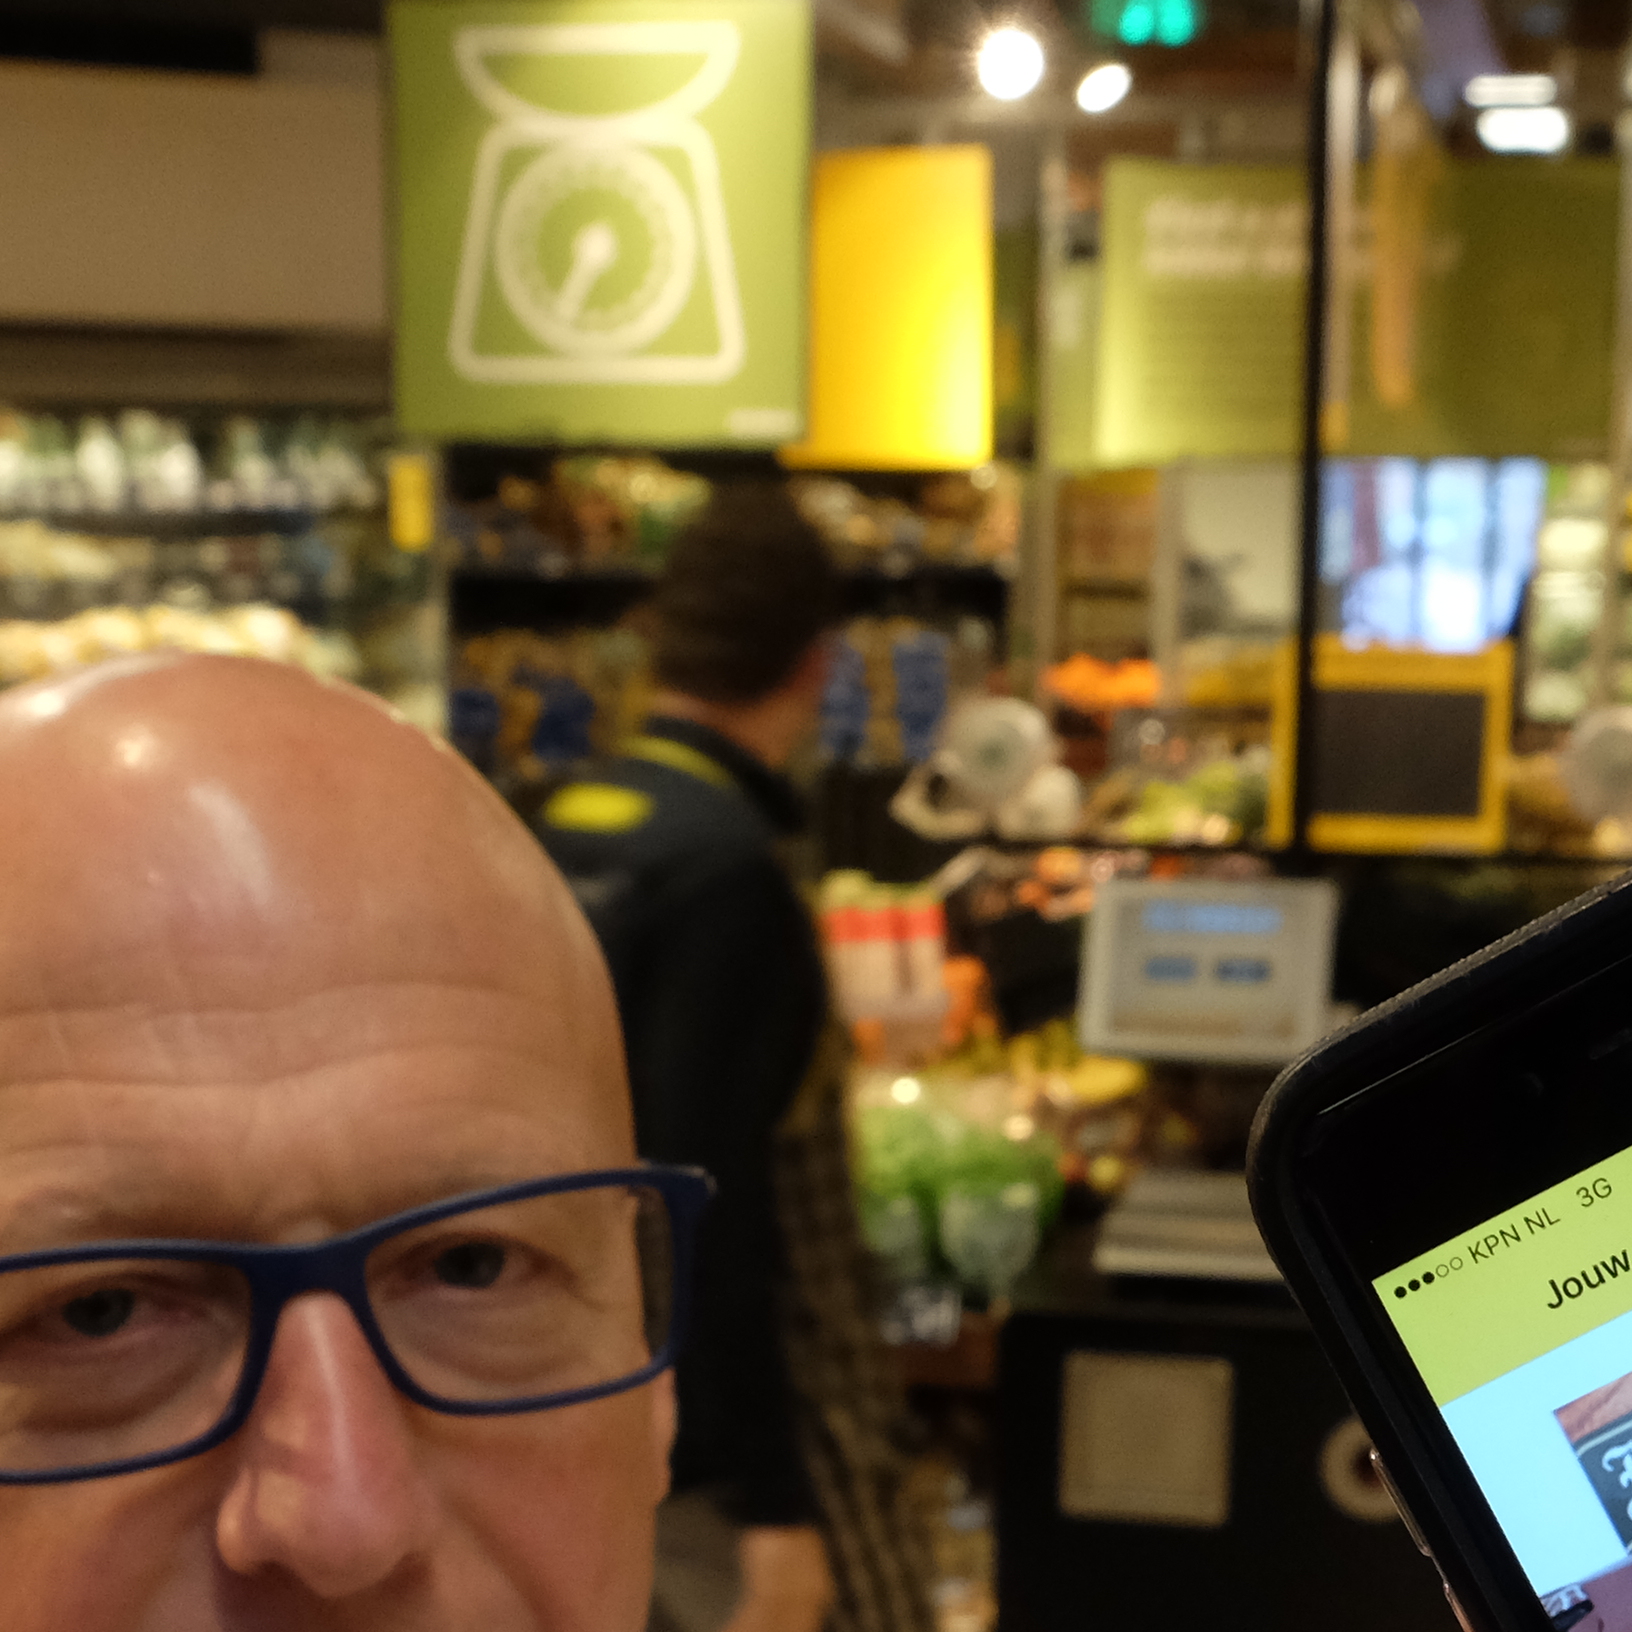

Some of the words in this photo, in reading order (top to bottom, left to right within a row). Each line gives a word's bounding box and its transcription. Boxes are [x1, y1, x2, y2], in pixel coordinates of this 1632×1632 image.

[1467, 1223, 1522, 1264] KPN
[1523, 1207, 1562, 1235] NL
[1575, 1177, 1613, 1208] 3G
[1546, 1249, 1631, 1310] Jouw
